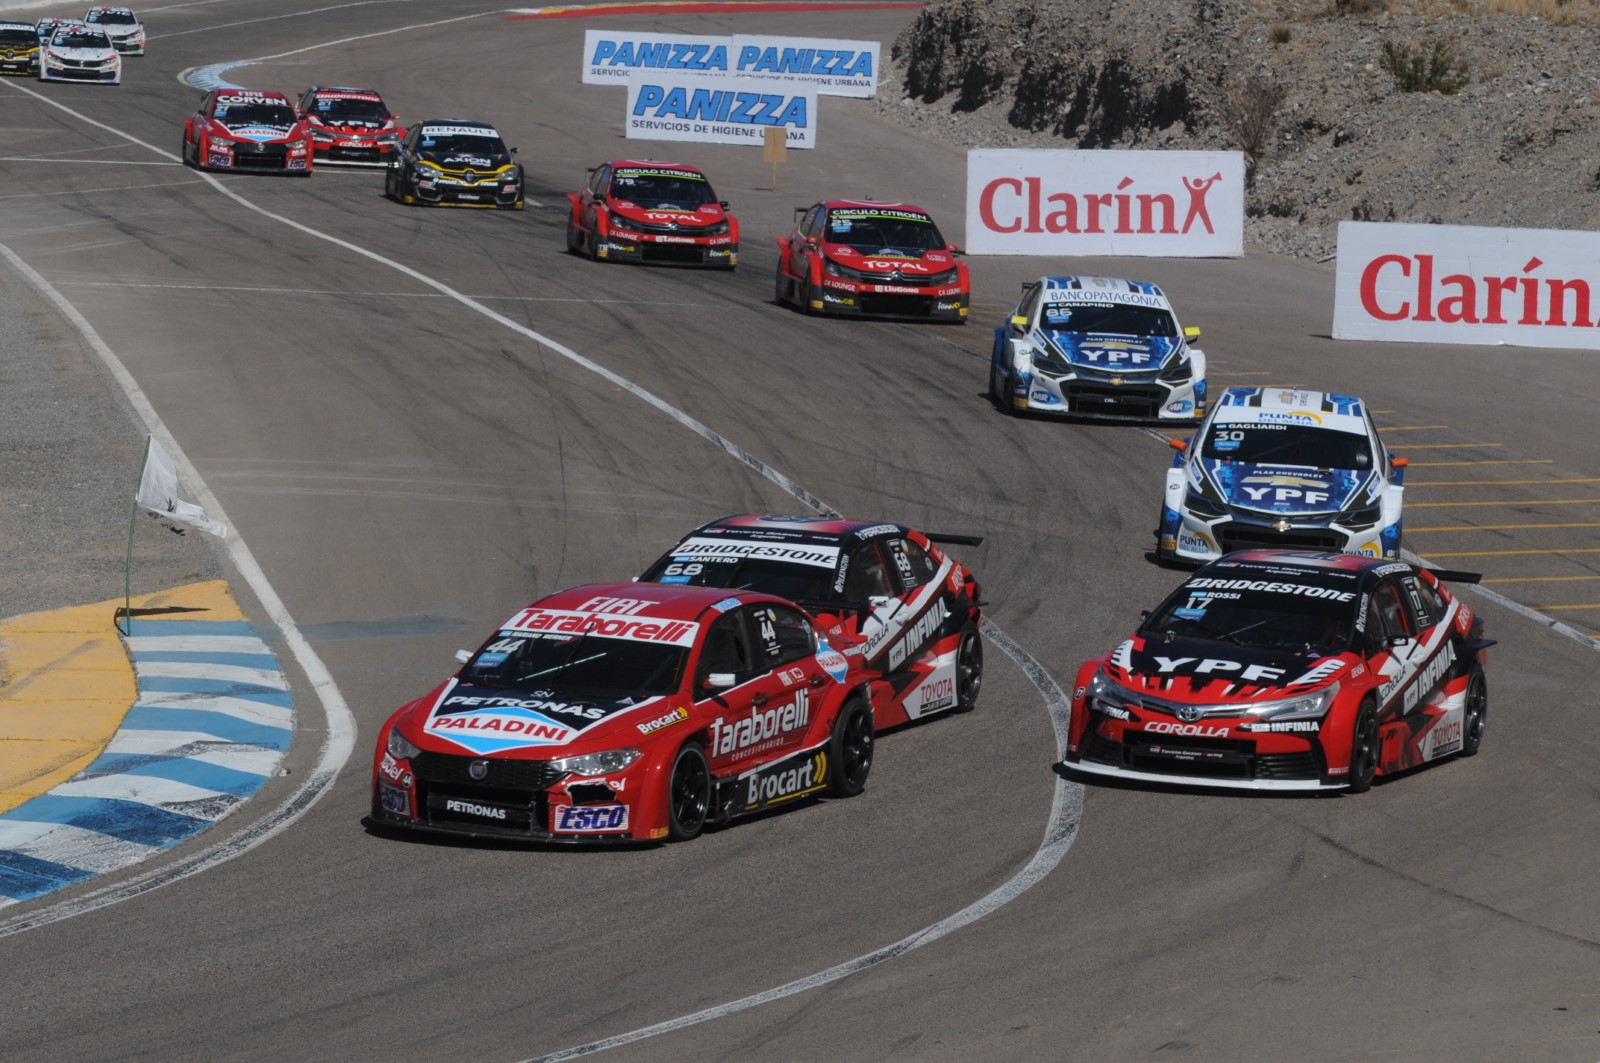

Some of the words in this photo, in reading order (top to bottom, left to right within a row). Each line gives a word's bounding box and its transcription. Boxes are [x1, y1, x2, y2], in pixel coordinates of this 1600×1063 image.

[57, 30, 105, 38] CIVIC
[592, 40, 728, 71] PANIZZA
[736, 46, 872, 77] PANIZZA
[217, 95, 287, 106] CORVEN
[316, 93, 380, 102] BRIDGESTONE
[633, 84, 807, 128] PANIZZA
[227, 123, 291, 131] PETRONAS
[328, 120, 379, 128] YPF
[426, 127, 494, 136] RENAULT
[632, 120, 690, 132] SERVICIOS
[694, 124, 708, 133] DE
[712, 126, 756, 137] HIGIENE
[233, 129, 287, 137] PALADINI
[443, 157, 491, 165] AXION
[617, 178, 635, 186] 79
[979, 176, 1179, 235] Clarín
[643, 212, 702, 222] TOTAL
[832, 219, 852, 227] 25
[617, 231, 638, 241] LOUNGE
[863, 260, 928, 271] TOTAL
[832, 280, 856, 292] LOUNGE
[1360, 253, 1592, 328] Clarín
[1051, 290, 1162, 307] BANCOPATAGONIA
[1046, 308, 1072, 317] 86
[1080, 350, 1151, 363] YPF
[1259, 412, 1313, 422] PUNTA
[1228, 423, 1287, 431] GAGLIARDI
[1215, 431, 1245, 441] 30
[1242, 487, 1330, 504] YPF
[1180, 534, 1208, 547] PUNTA
[677, 543, 838, 564] BRIDGESTONE
[688, 556, 739, 564] SANTERO
[664, 563, 704, 576] 68
[1185, 578, 1357, 602] BRIDGESTONE
[1206, 591, 1241, 599] ROSSI
[576, 596, 660, 615] FIAT
[1185, 597, 1214, 609] 17
[515, 609, 693, 642] Taraborelli
[761, 620, 776, 641] 44
[906, 596, 946, 657] INFINIA
[511, 631, 542, 639] MARIANO
[860, 623, 889, 654] COROLLA
[486, 638, 527, 653] 44
[1152, 656, 1287, 681] YPF
[1419, 639, 1453, 700] INFINIA
[920, 677, 953, 704] TOYOTA
[443, 696, 607, 720] PETRONAS
[431, 717, 570, 741] PALADINI
[636, 711, 681, 735] Brocart
[710, 687, 809, 758] Taraborelli
[1144, 721, 1229, 738] COROLLA
[1271, 721, 1320, 732] INFINIA
[1433, 720, 1461, 746] TOYOTA
[731, 737, 784, 762] CONCESIONARIOS
[747, 758, 813, 804] Brocart
[446, 799, 506, 819] PETRONAS
[559, 805, 627, 829] ESCO
